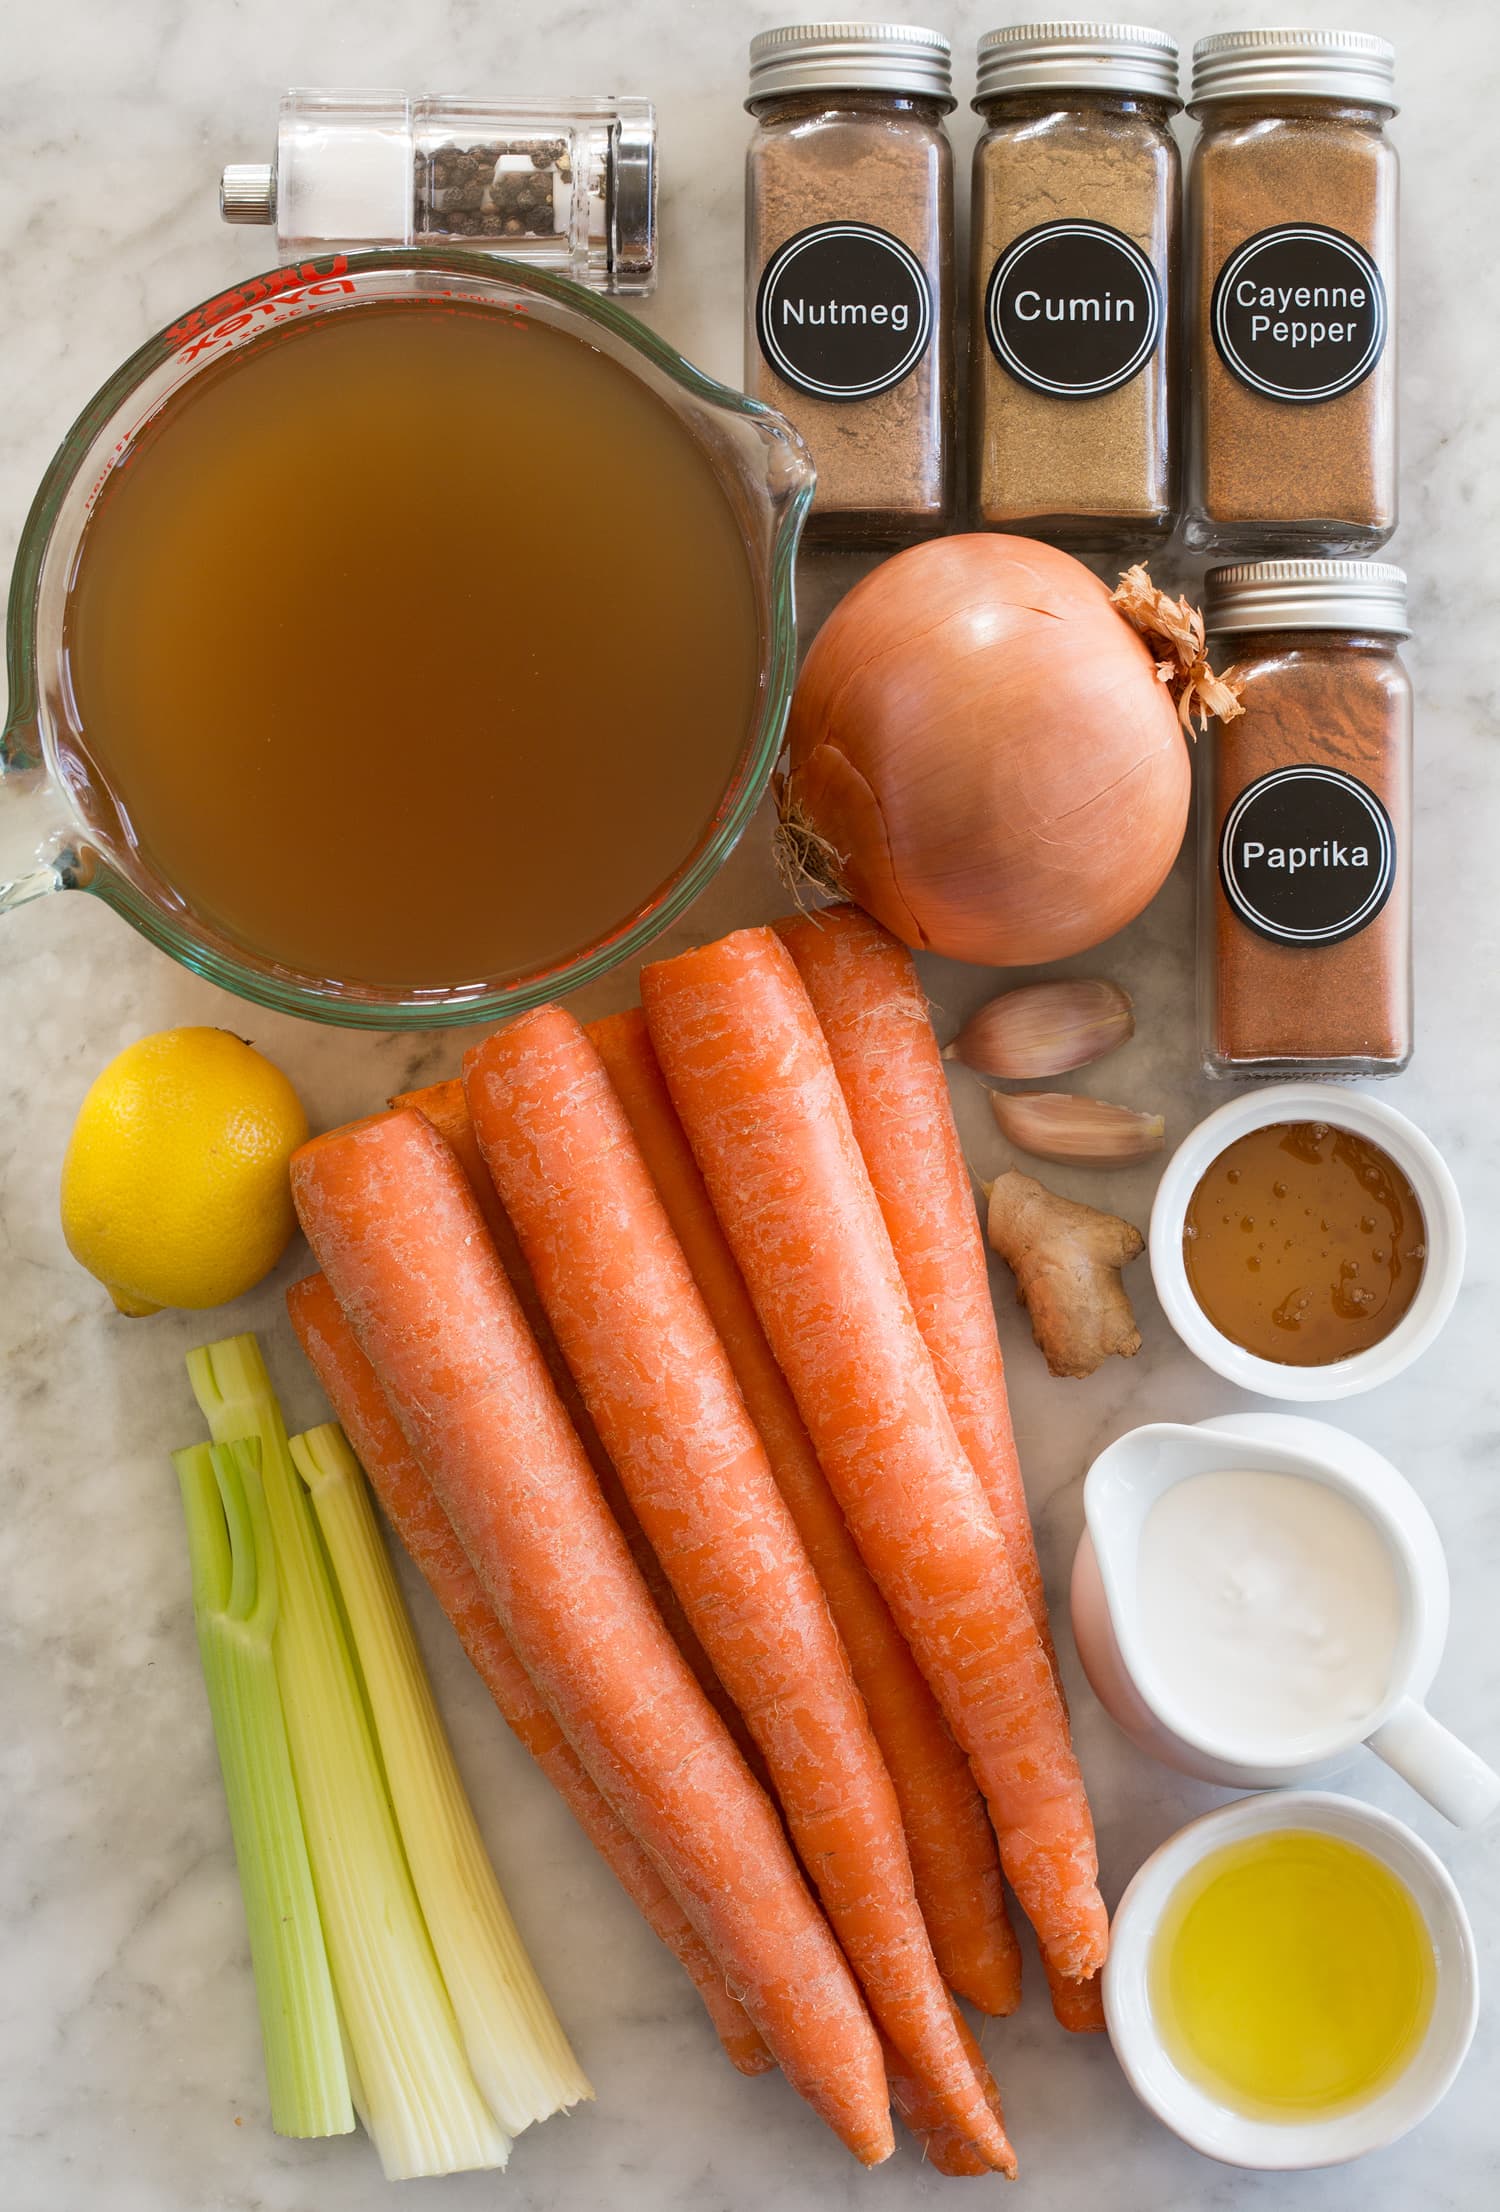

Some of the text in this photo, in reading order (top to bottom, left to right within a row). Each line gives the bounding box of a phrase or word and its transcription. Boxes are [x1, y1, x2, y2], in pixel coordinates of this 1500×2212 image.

[1013, 290, 1136, 322] Cumin
[1236, 280, 1367, 314] Cayenne
[782, 299, 909, 331] Nutmeg
[1251, 315, 1358, 349] Pepper
[1242, 841, 1370, 874] Paprika
